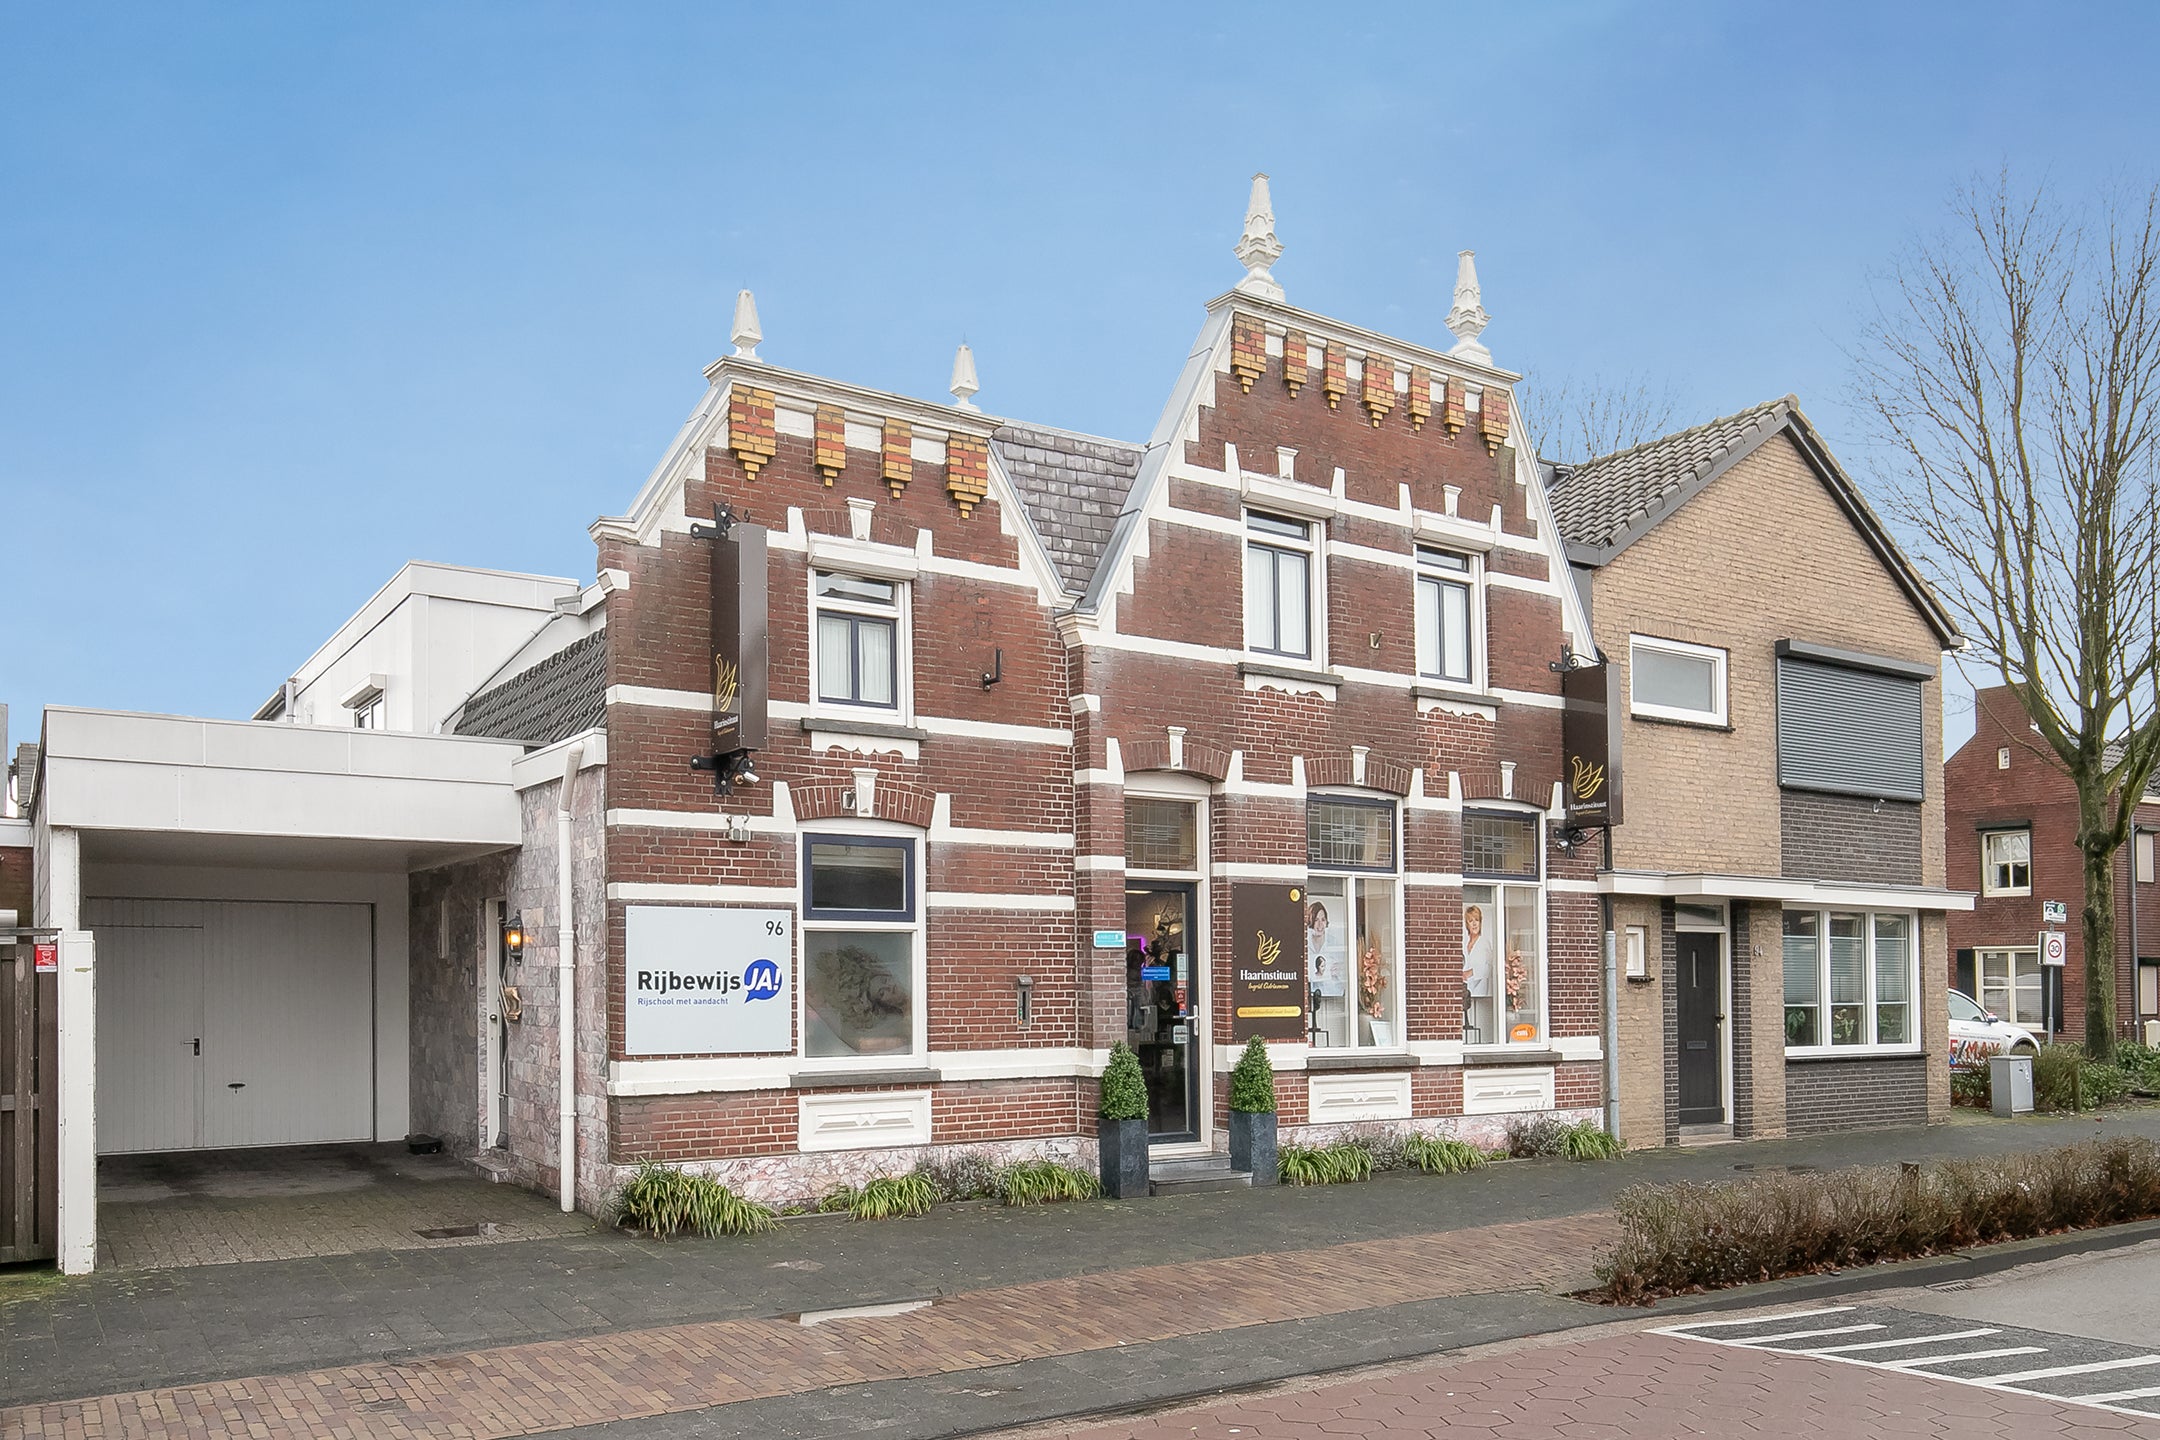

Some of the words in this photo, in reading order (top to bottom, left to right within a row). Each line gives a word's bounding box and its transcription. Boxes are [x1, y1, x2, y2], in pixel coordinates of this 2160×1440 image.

[765, 920, 784, 936] 96
[2051, 945, 2060, 953] 30
[637, 970, 741, 995] Rijbewijs
[744, 967, 782, 991] JA!
[1240, 969, 1298, 981] Haarinstituut
[637, 997, 674, 1007] Rijschool
[693, 997, 729, 1005] aandacht
